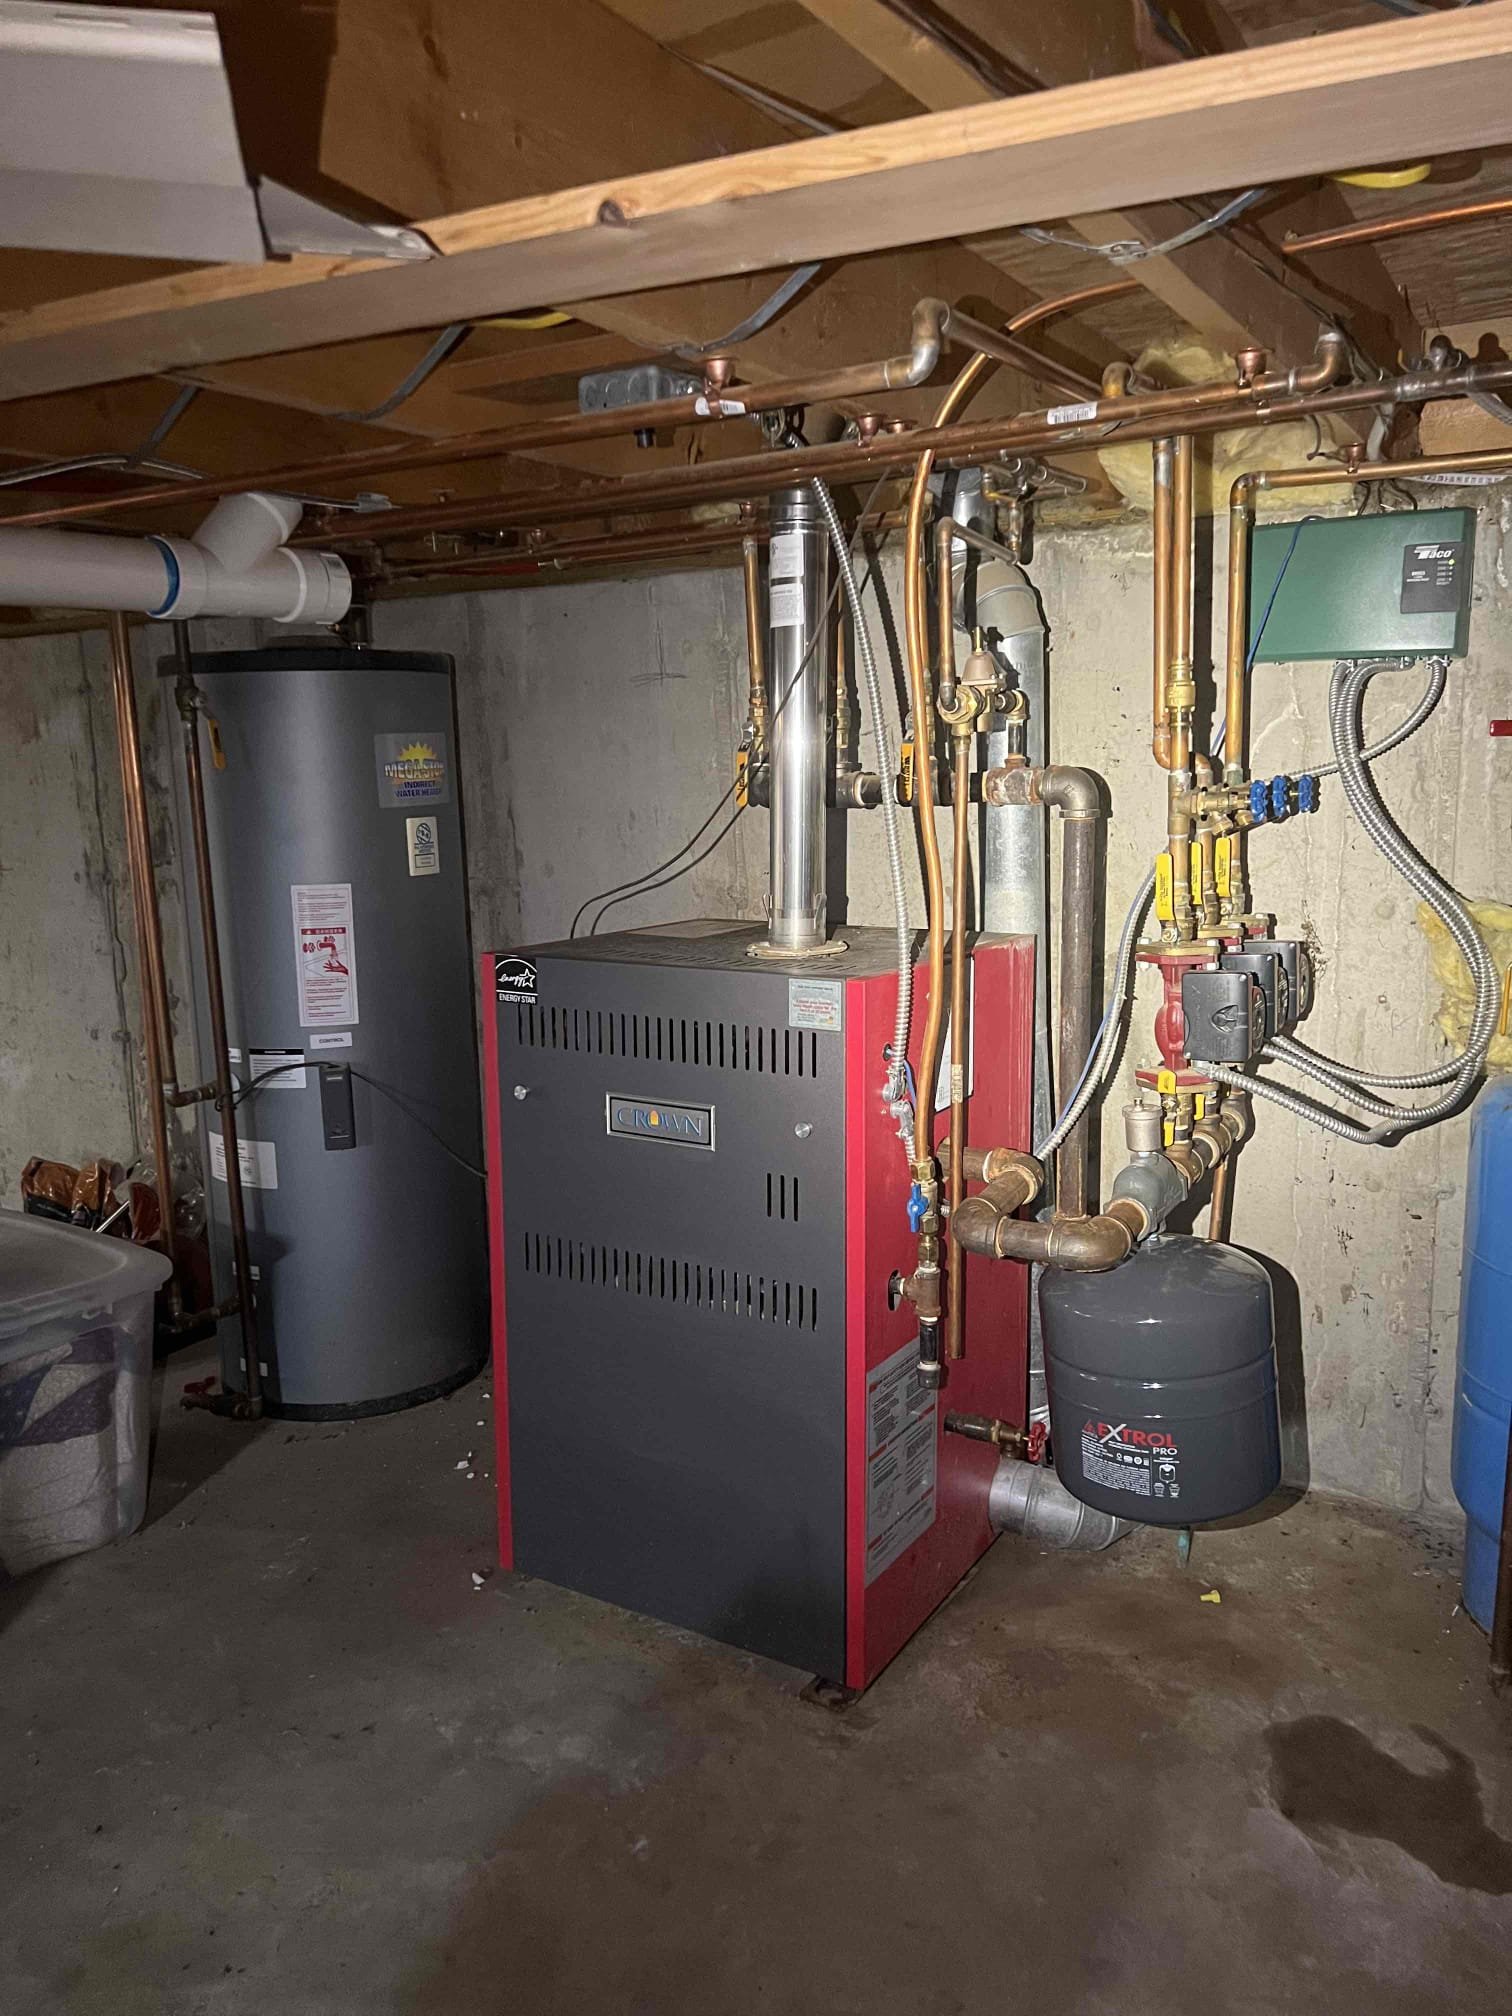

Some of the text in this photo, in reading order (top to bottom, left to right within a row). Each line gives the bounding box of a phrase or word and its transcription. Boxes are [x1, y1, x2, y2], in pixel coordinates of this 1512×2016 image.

[499, 993, 536, 1004] ENERGY STAR
[617, 1106, 704, 1137] CROWN
[1097, 1423, 1177, 1447] EXTROL
[1152, 1447, 1178, 1455] PRO
